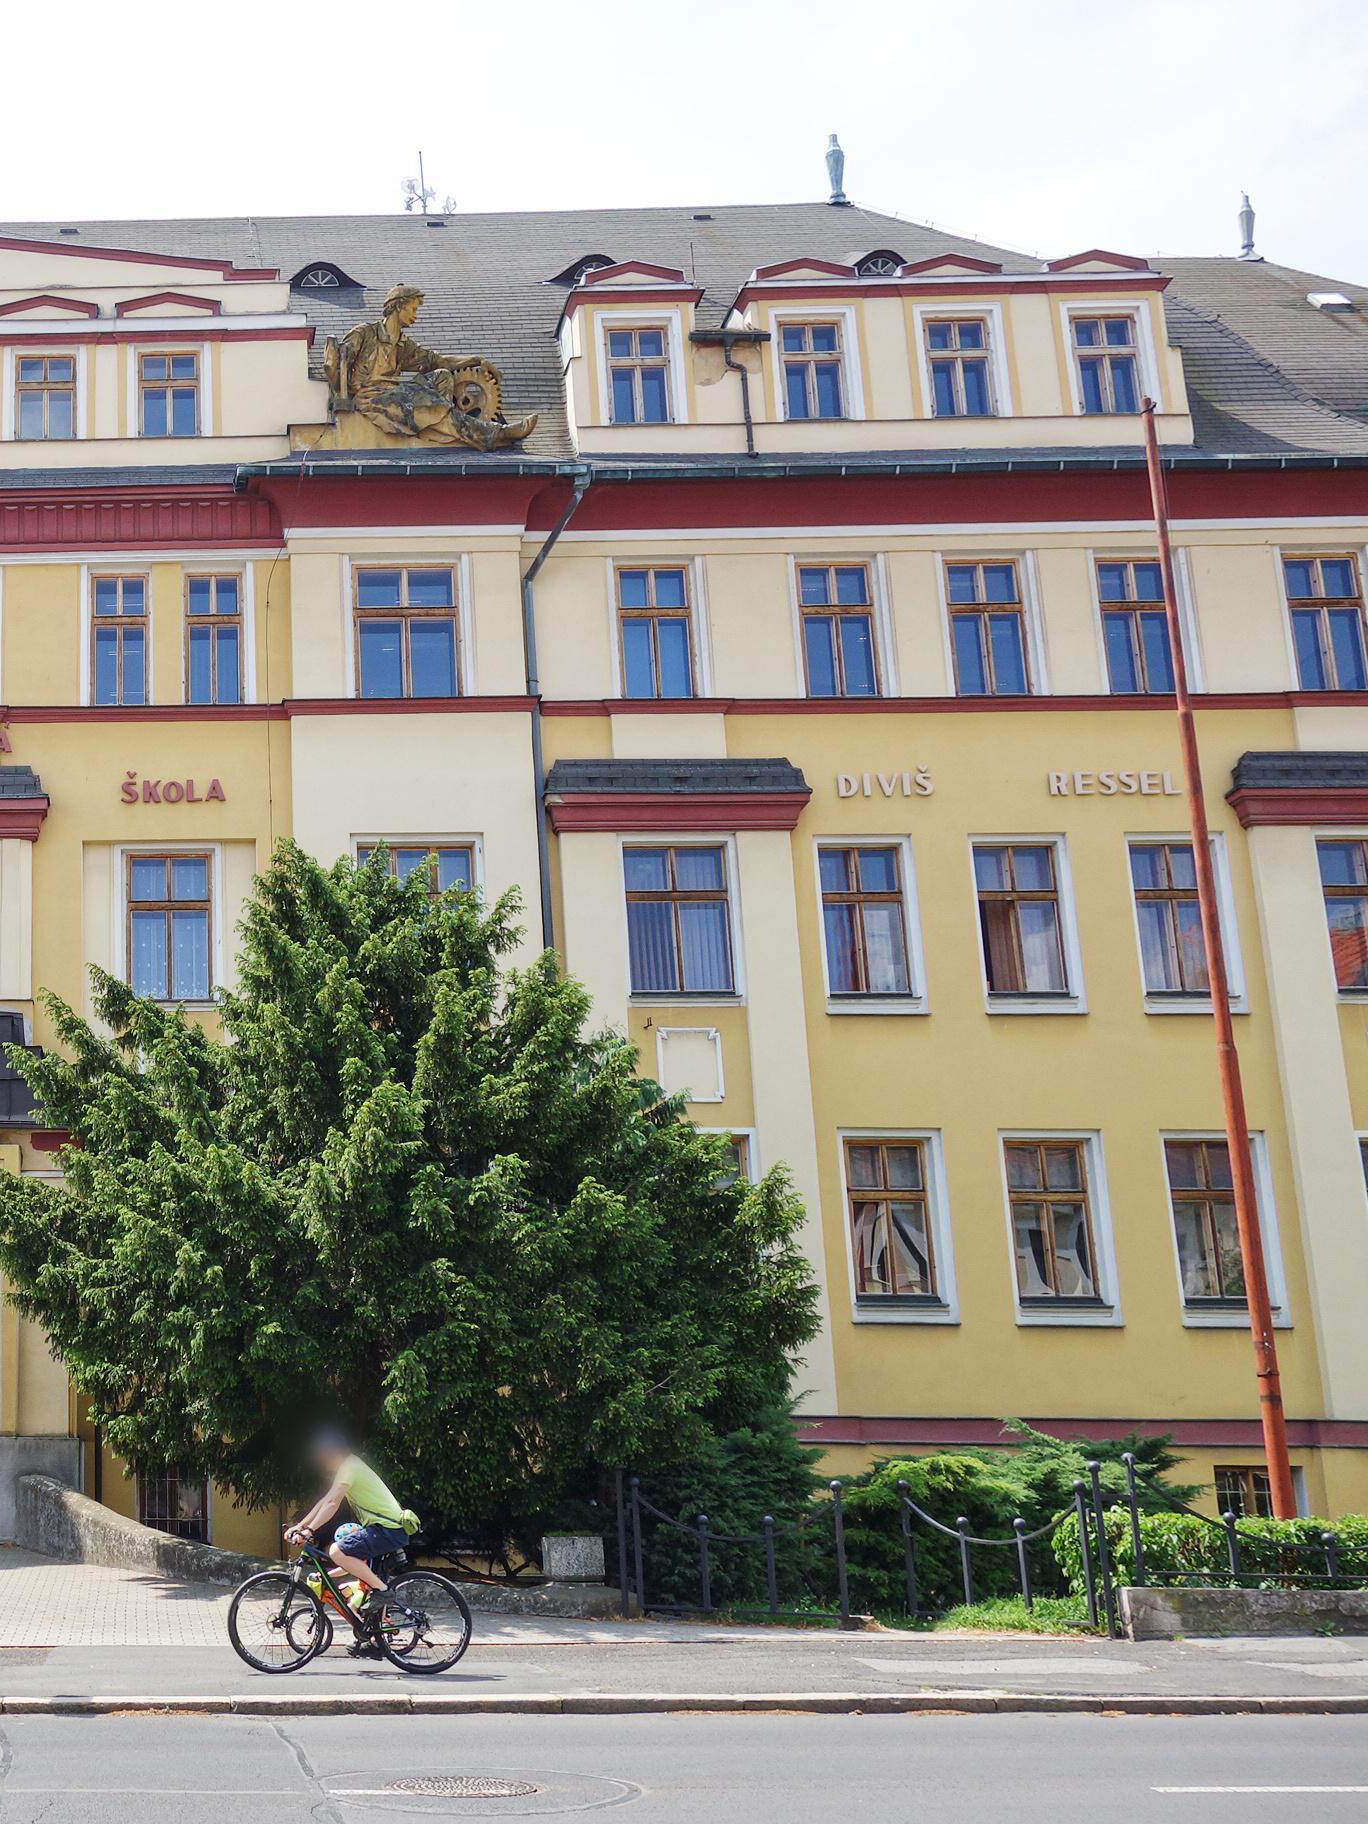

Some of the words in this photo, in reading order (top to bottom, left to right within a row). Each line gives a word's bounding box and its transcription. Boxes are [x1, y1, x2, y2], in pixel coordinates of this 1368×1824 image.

[120, 770, 227, 804] ŠKOLA
[837, 763, 934, 797] DIVIŠ
[1048, 770, 1182, 796] RESSEL
